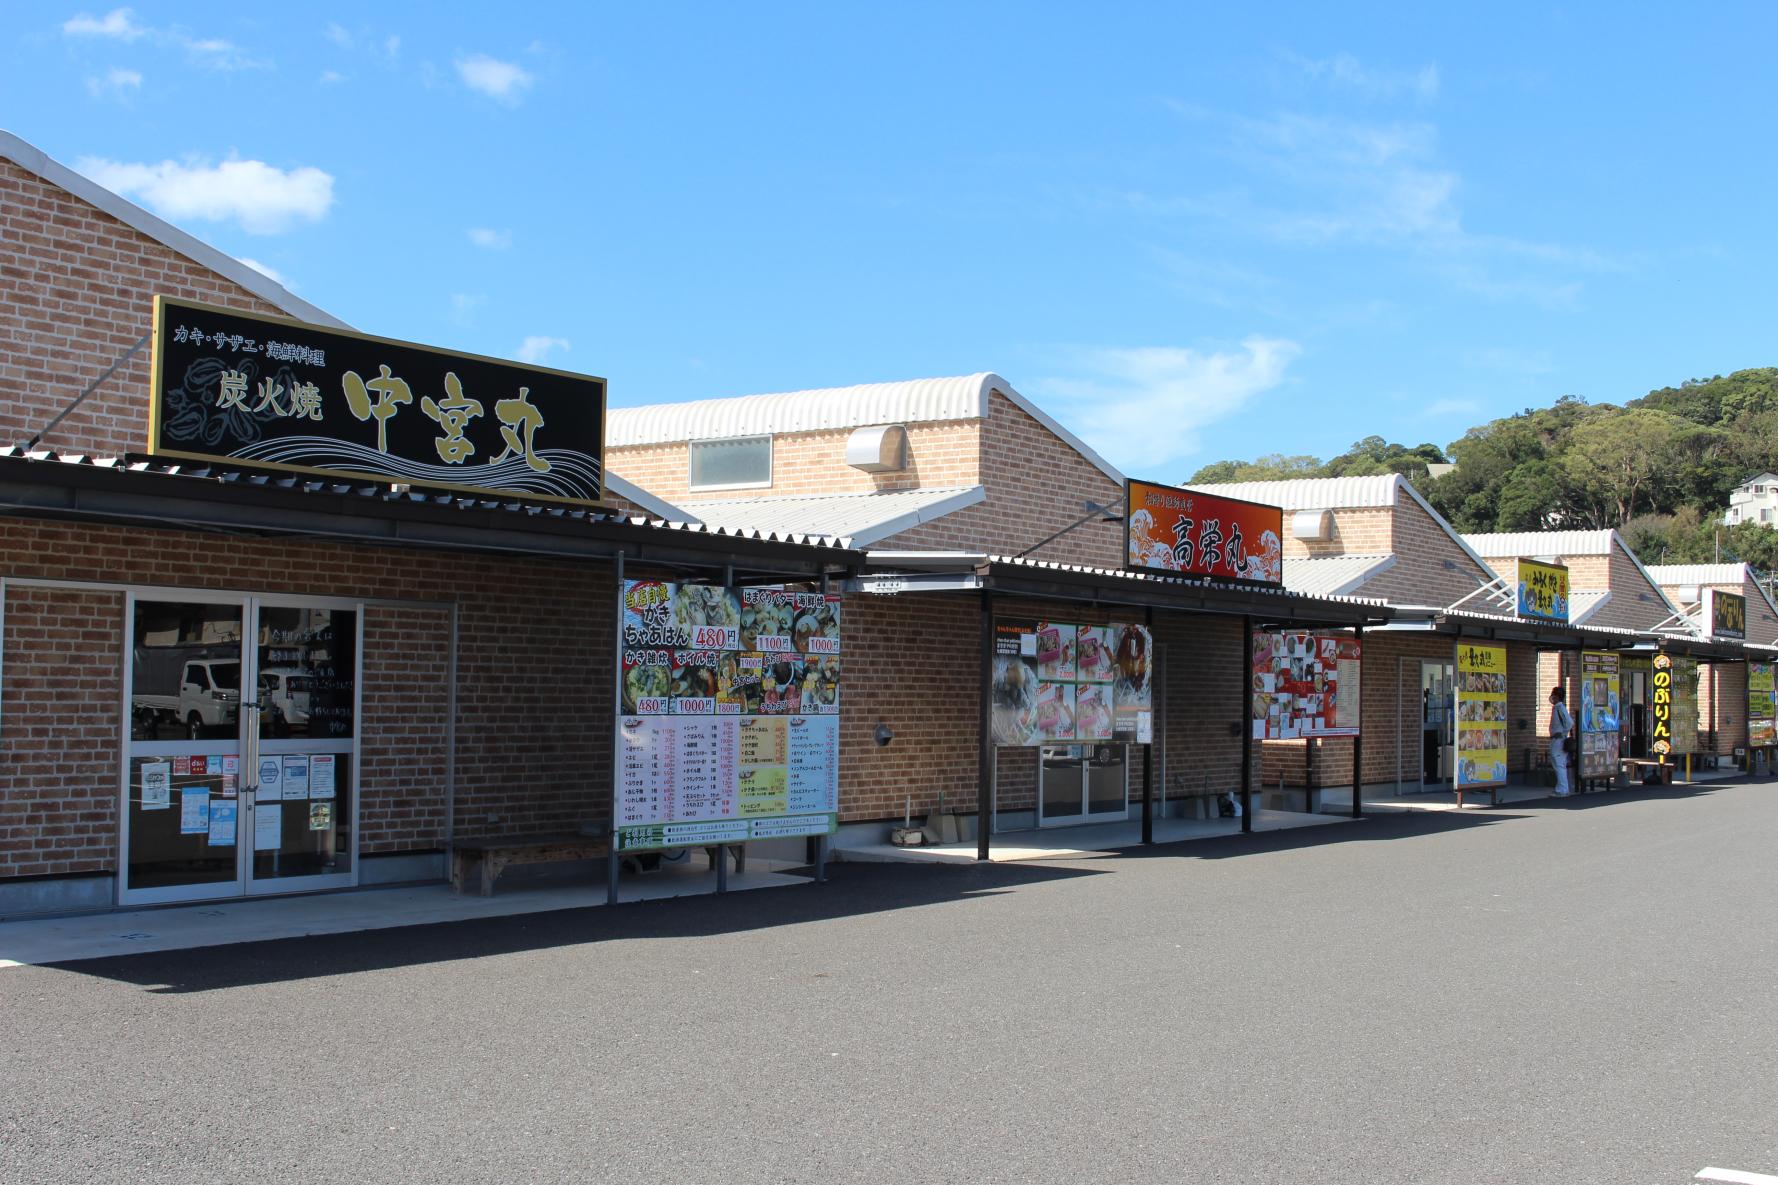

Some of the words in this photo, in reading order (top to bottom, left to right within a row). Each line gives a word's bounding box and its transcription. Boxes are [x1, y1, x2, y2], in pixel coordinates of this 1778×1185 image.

[216, 370, 324, 420] 炭火焼
[342, 364, 552, 472] 中宮丸
[625, 584, 670, 609] 当店自慢
[644, 604, 671, 625] かき
[625, 624, 689, 646] ちゃあはん
[695, 627, 736, 649] 480円
[758, 638, 789, 651] 1100円
[625, 651, 669, 666] かき雑炊
[677, 652, 717, 666] ホイル焼
[639, 699, 667, 713] 480円
[680, 699, 712, 713] 1000円
[1654, 672, 1670, 737] のぶりん
